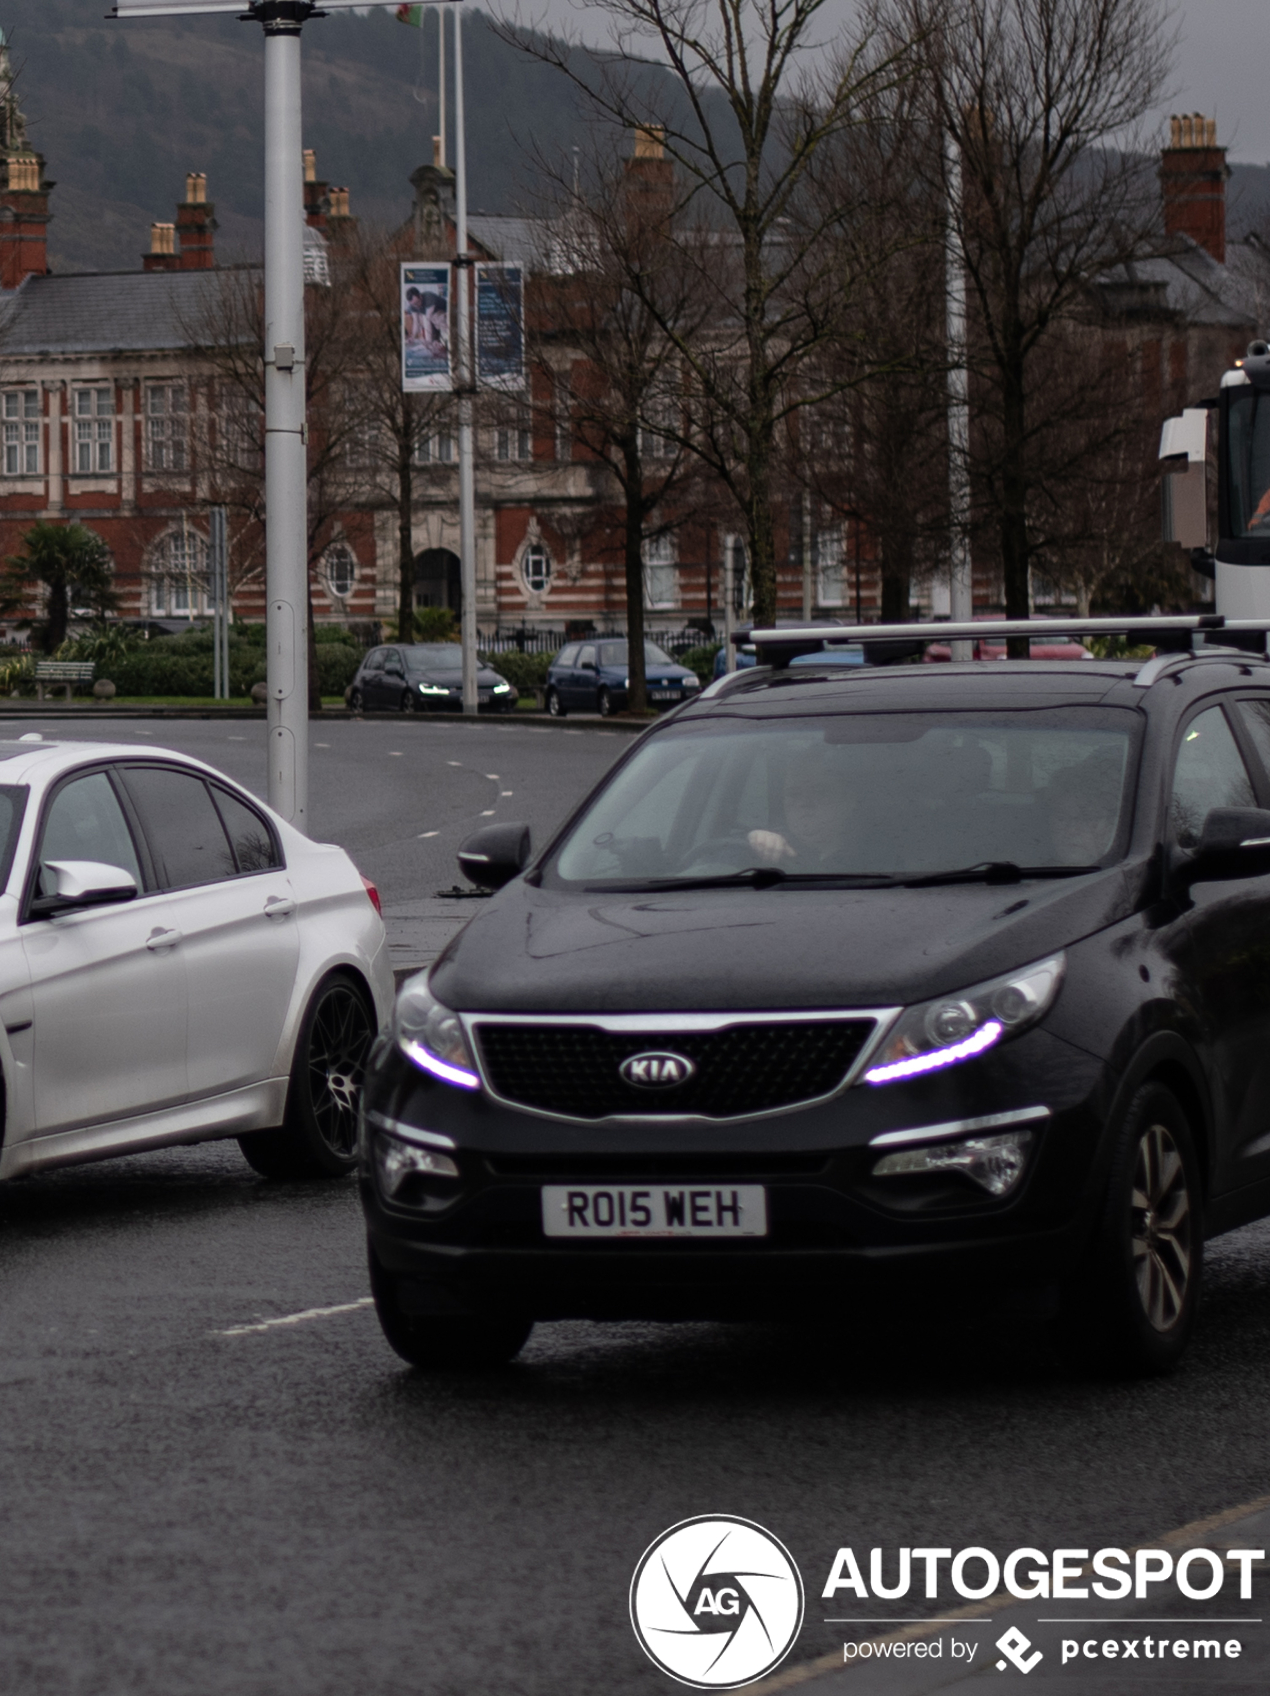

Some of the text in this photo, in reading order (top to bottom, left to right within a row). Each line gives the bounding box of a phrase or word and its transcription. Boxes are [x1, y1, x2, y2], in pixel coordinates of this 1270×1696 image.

[631, 1060, 680, 1080] KIA
[567, 1190, 740, 1228] RO15 WEH
